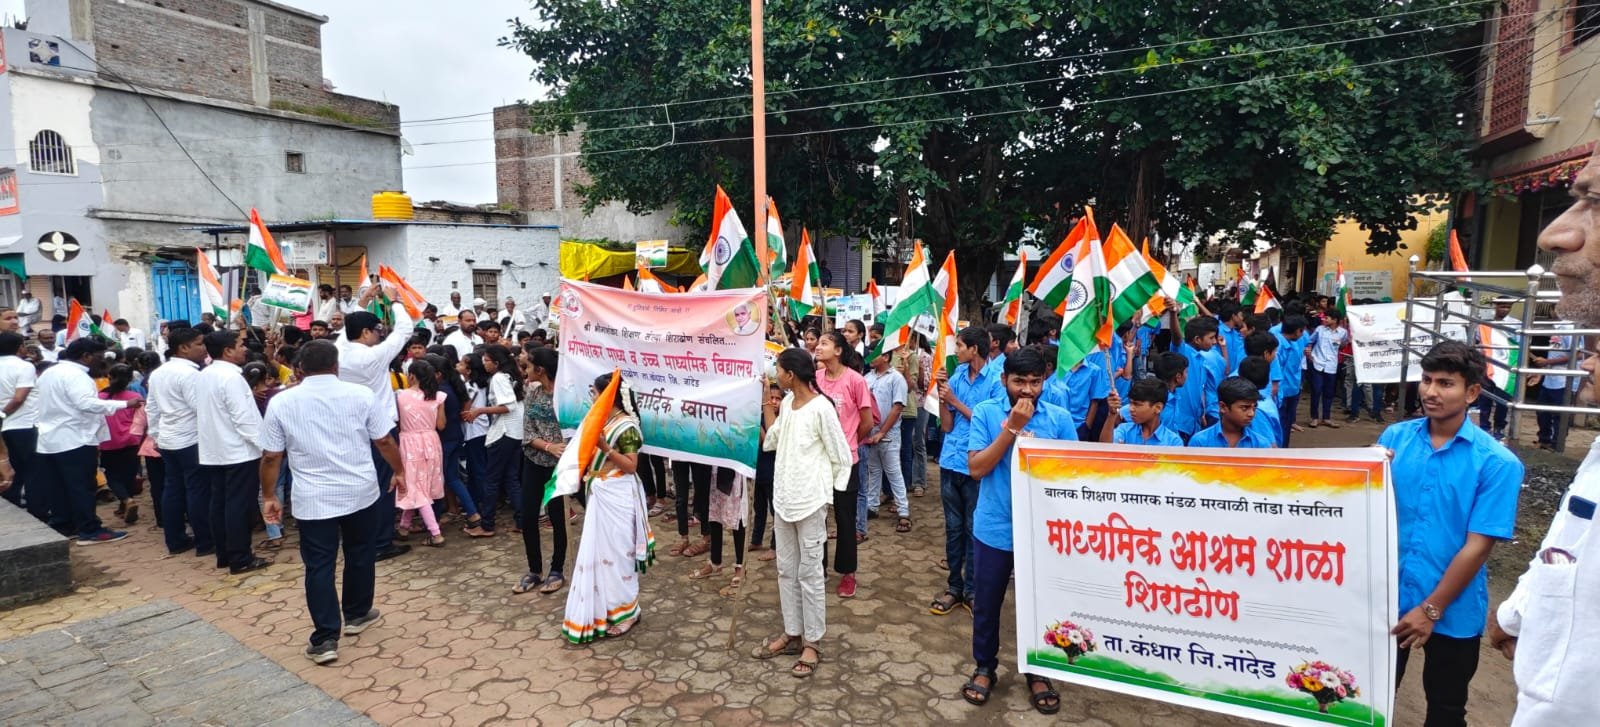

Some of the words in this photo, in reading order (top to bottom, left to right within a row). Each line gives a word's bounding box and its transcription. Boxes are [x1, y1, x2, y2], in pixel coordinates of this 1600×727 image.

[621, 327, 641, 340] शिक्षण
[629, 351, 638, 366] व
[640, 352, 660, 368] उच्च
[662, 351, 708, 373] माध्यमिक
[636, 387, 674, 415] हार्दिक
[680, 399, 728, 424] स्वागत
[1044, 487, 1078, 500] बालक
[1081, 486, 1117, 503] शिक्षण
[1120, 492, 1162, 506] प्रसारक
[1165, 491, 1197, 508] मंडळ
[1200, 496, 1249, 512] मरवाळी
[1252, 497, 1283, 515] तांडा
[1287, 499, 1344, 518] संचलित
[1046, 512, 1162, 567] माध्यमिक
[1168, 530, 1258, 578] आश्रम
[1266, 537, 1347, 587] शाळा
[1124, 570, 1241, 622] शिराढोण
[1103, 634, 1182, 664] ता.कंधार
[1188, 642, 1276, 679] जि.नांदेड
